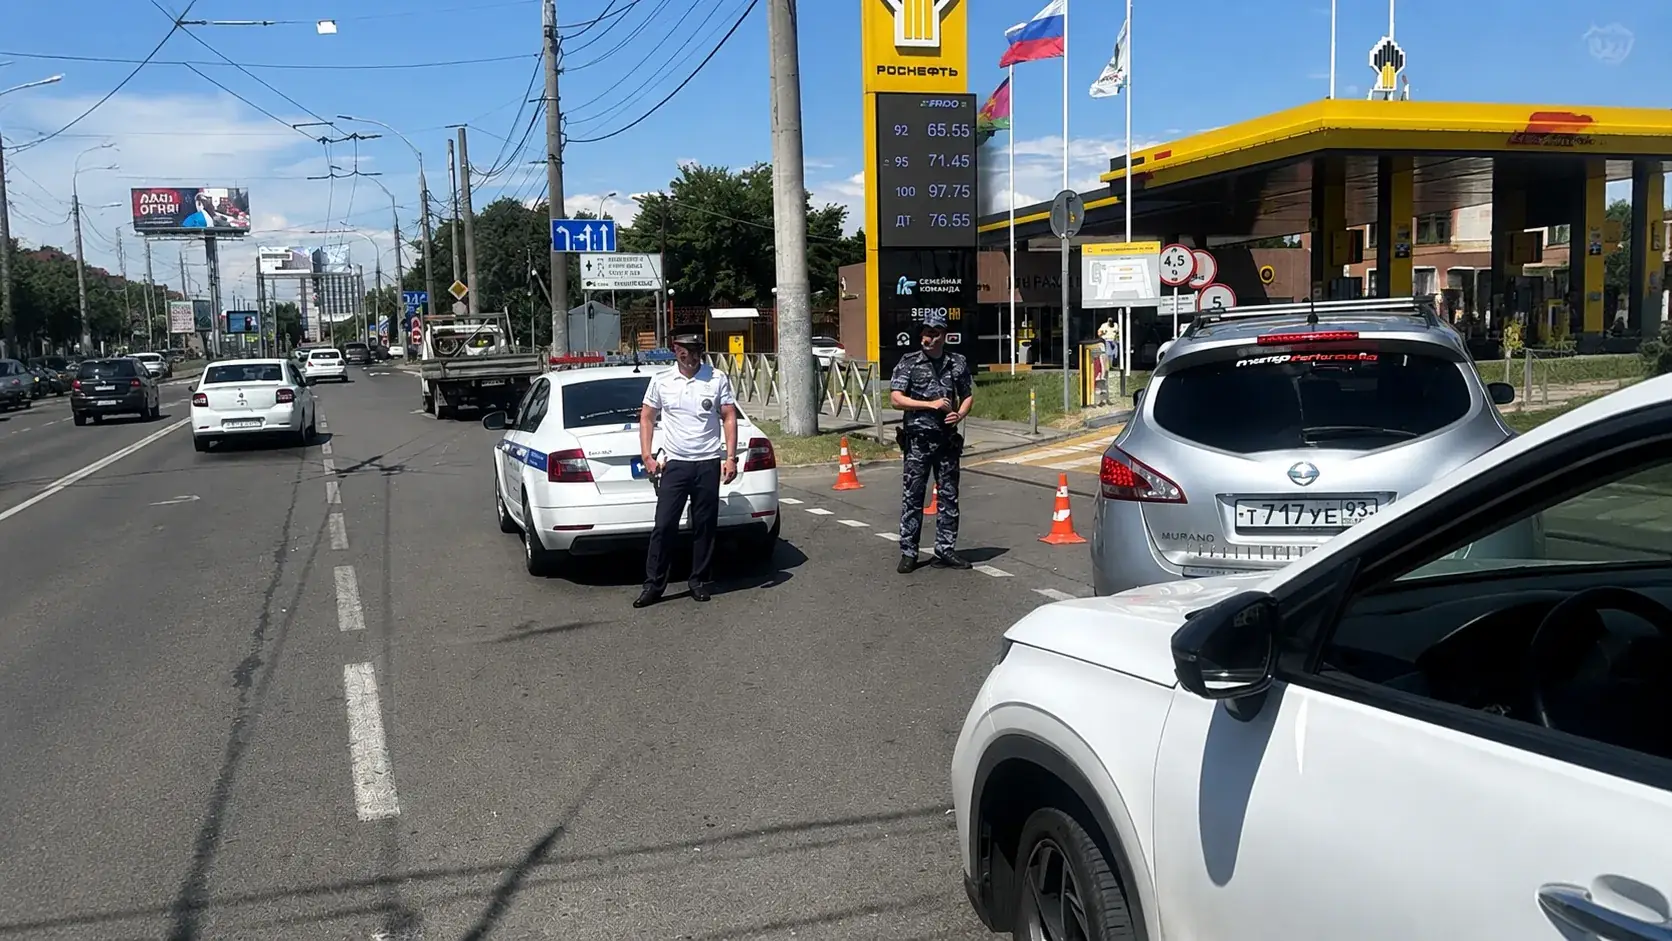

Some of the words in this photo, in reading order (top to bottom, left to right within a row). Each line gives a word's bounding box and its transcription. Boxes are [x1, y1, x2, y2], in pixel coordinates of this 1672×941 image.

[876, 65, 959, 77] РОСНЕФТЬ
[894, 124, 909, 136] 92
[927, 123, 970, 137] 65.55
[894, 156, 909, 168] 95
[928, 154, 970, 168] 71.45
[895, 186, 916, 197] 100
[928, 184, 970, 198] 97.75
[928, 213, 970, 227] 76.55
[919, 277, 962, 285] СЕМЕЙНАЯ
[1212, 296, 1222, 309] 5
[911, 307, 948, 317] ЗЕРНО
[1161, 532, 1215, 543] MURANO
